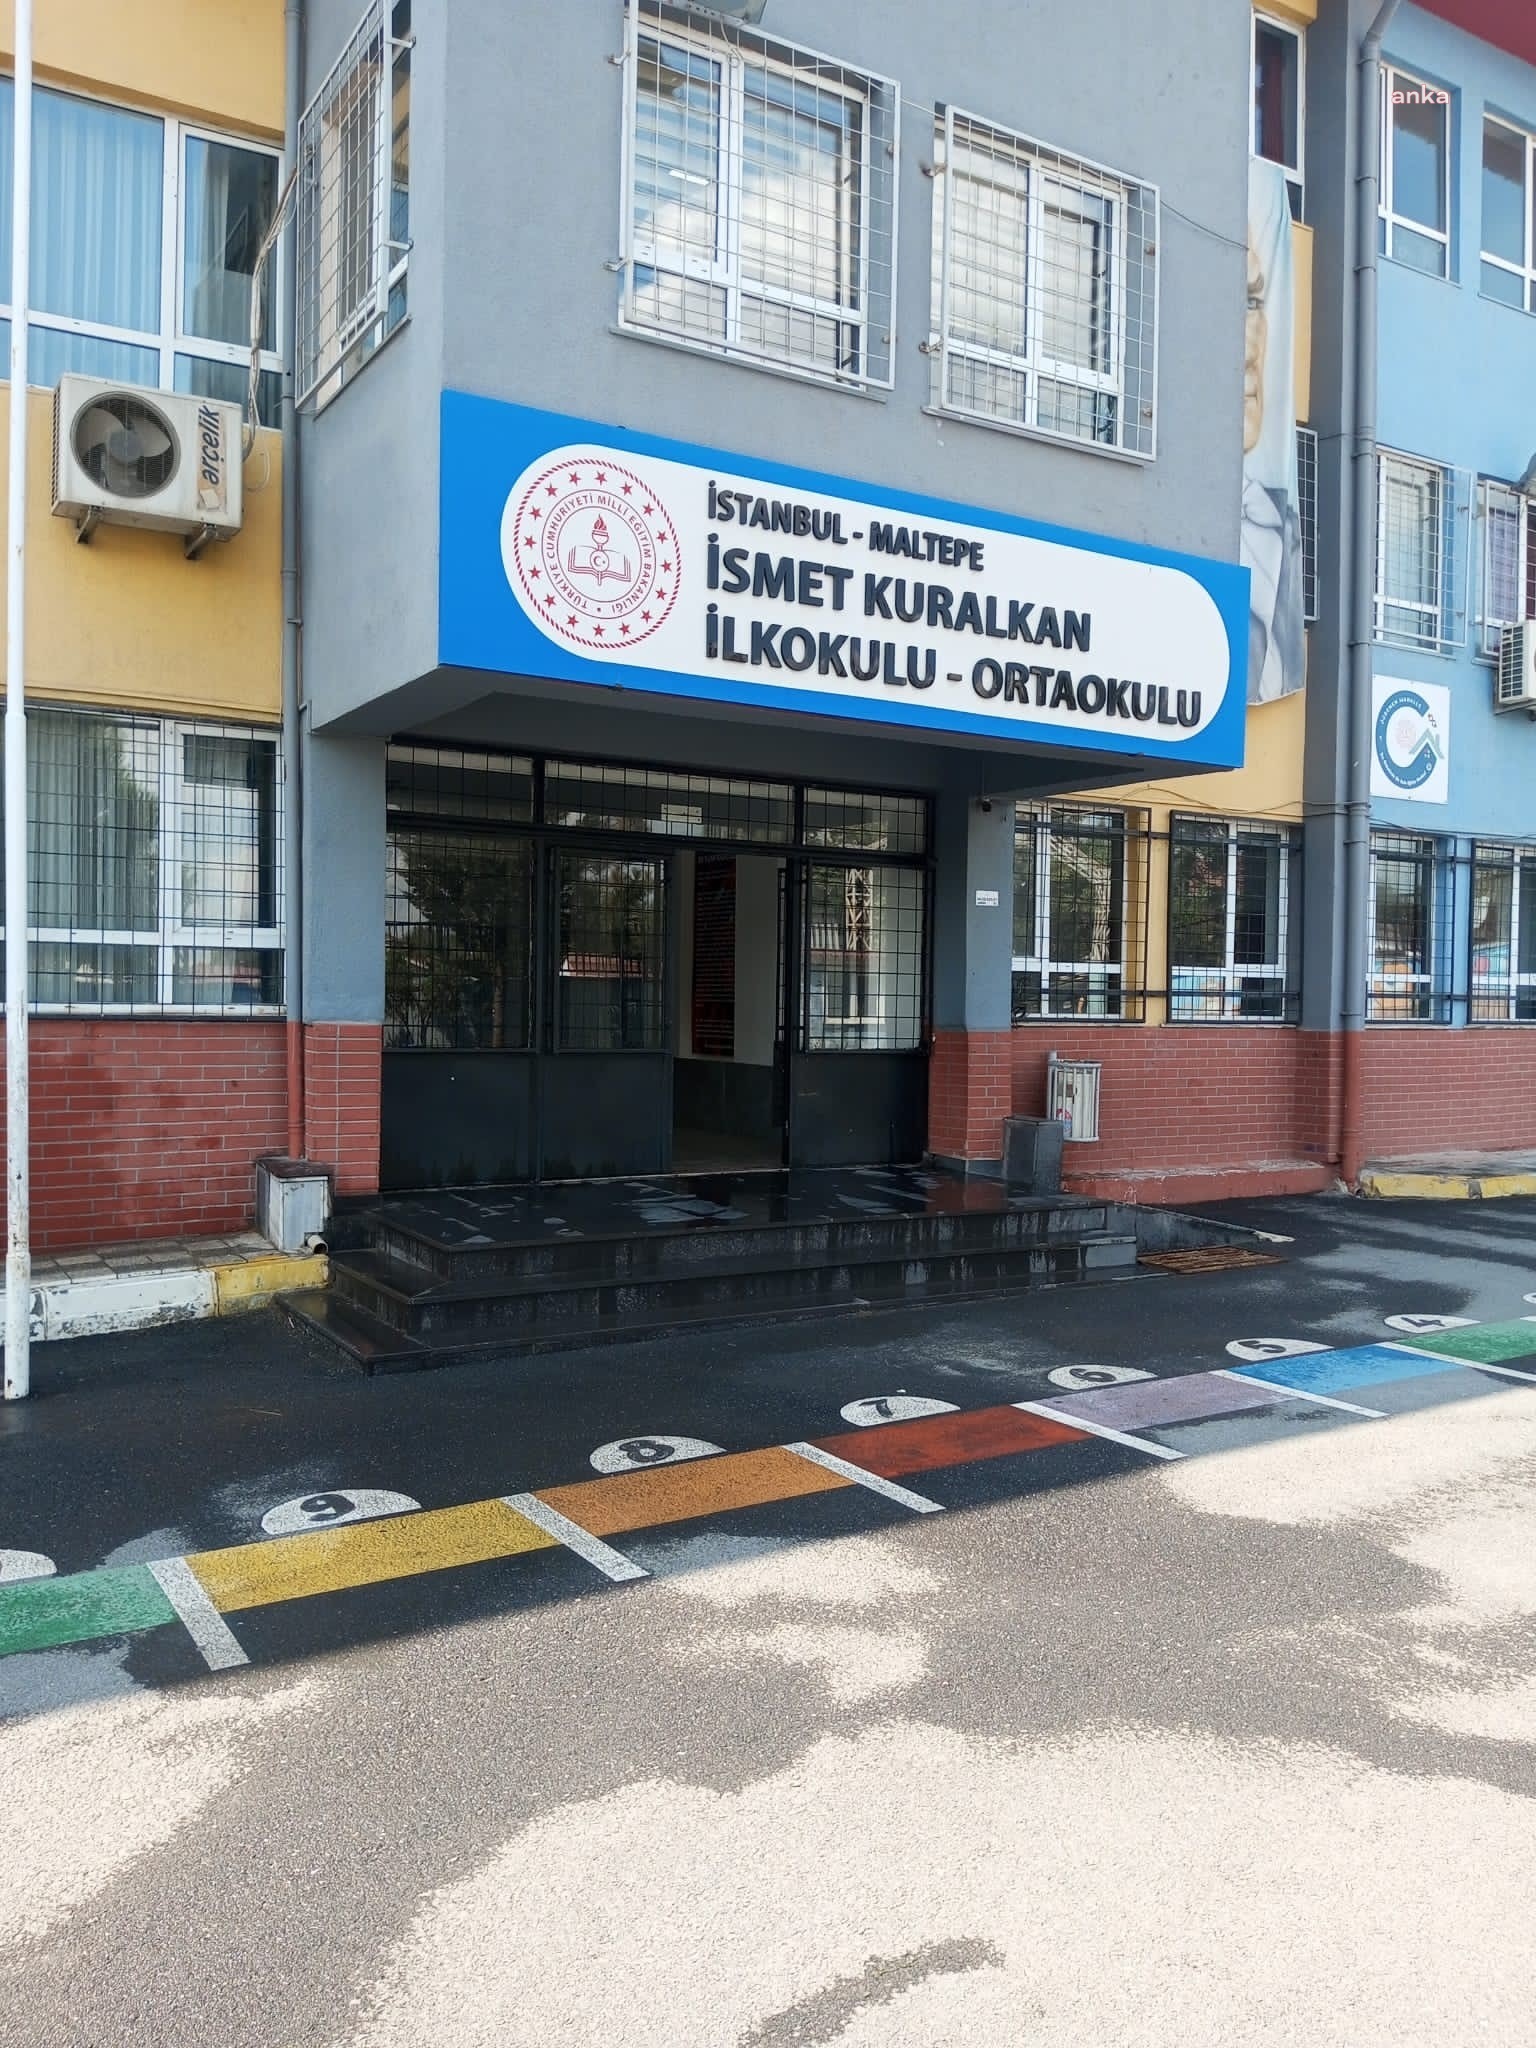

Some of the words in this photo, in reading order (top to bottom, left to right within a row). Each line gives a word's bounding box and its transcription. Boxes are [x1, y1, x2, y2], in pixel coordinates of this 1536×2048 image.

[198, 405, 224, 485] arçelik
[546, 492, 593, 558] CUMHURİYETİ
[628, 514, 652, 558] EĞİTİM
[707, 480, 847, 546] İSTANBUL
[869, 521, 984, 572] MALTEPE
[550, 563, 588, 609] TÜRKİYE
[612, 563, 652, 613] BAKANLIĞI
[707, 533, 854, 611] İSMET
[864, 573, 1091, 653] KURALKAN
[707, 603, 937, 690] İLKOKULU
[971, 657, 1202, 729] ORTAOKULU
[1400, 1316, 1446, 1328] 4
[1237, 1339, 1287, 1354] 5
[1069, 1367, 1117, 1383] 6
[859, 1398, 894, 1419] 7
[618, 1439, 675, 1464] 8
[300, 1493, 355, 1522] 9
